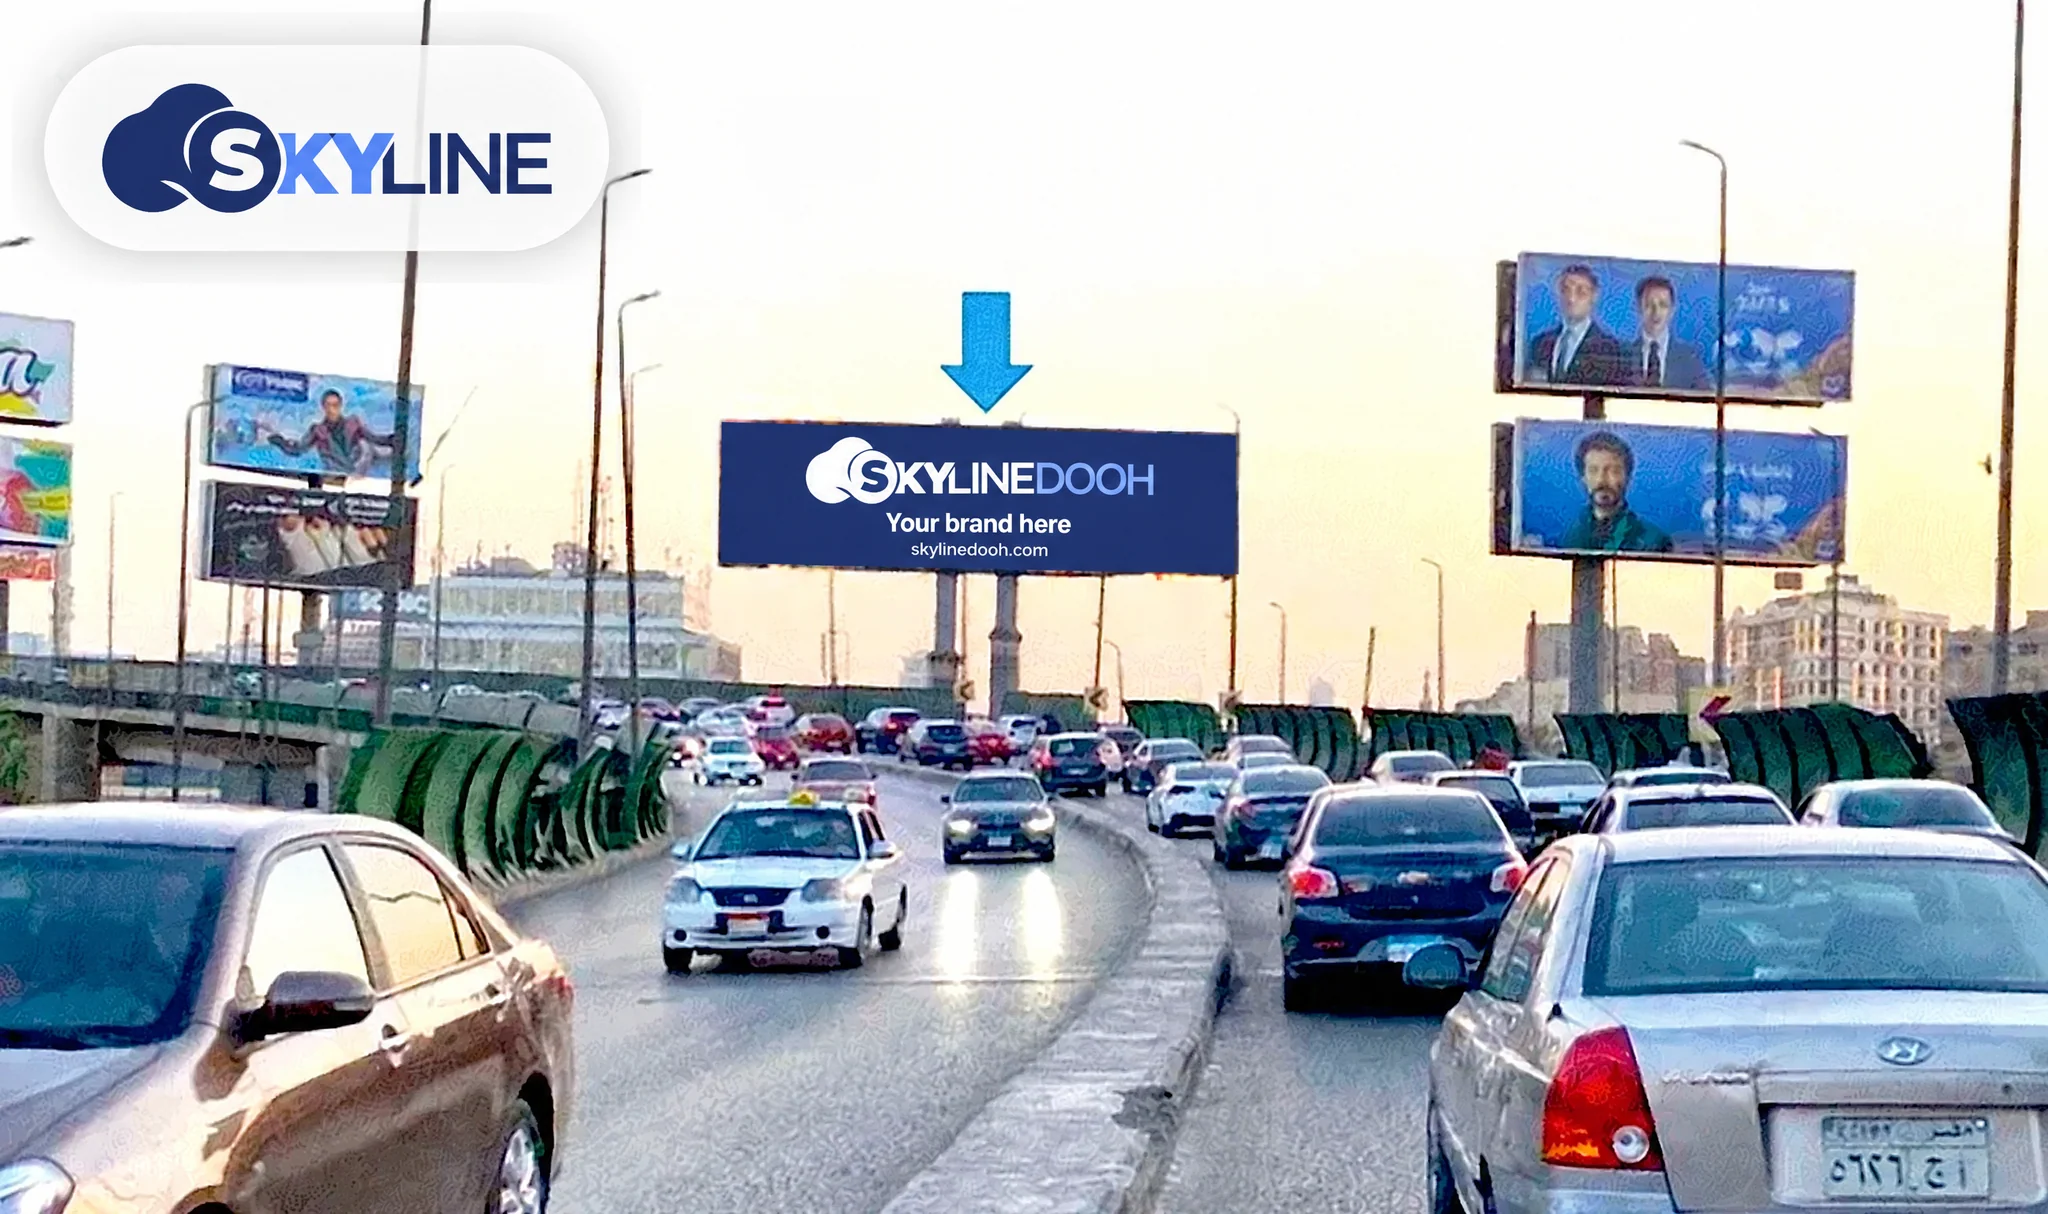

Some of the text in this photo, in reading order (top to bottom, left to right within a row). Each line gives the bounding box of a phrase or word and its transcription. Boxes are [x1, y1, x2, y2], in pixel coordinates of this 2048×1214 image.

[860, 459, 1155, 496] SKYLINEDOOH
[885, 512, 1072, 534] Your brand here
[910, 541, 1049, 560] skylinedooh.com
